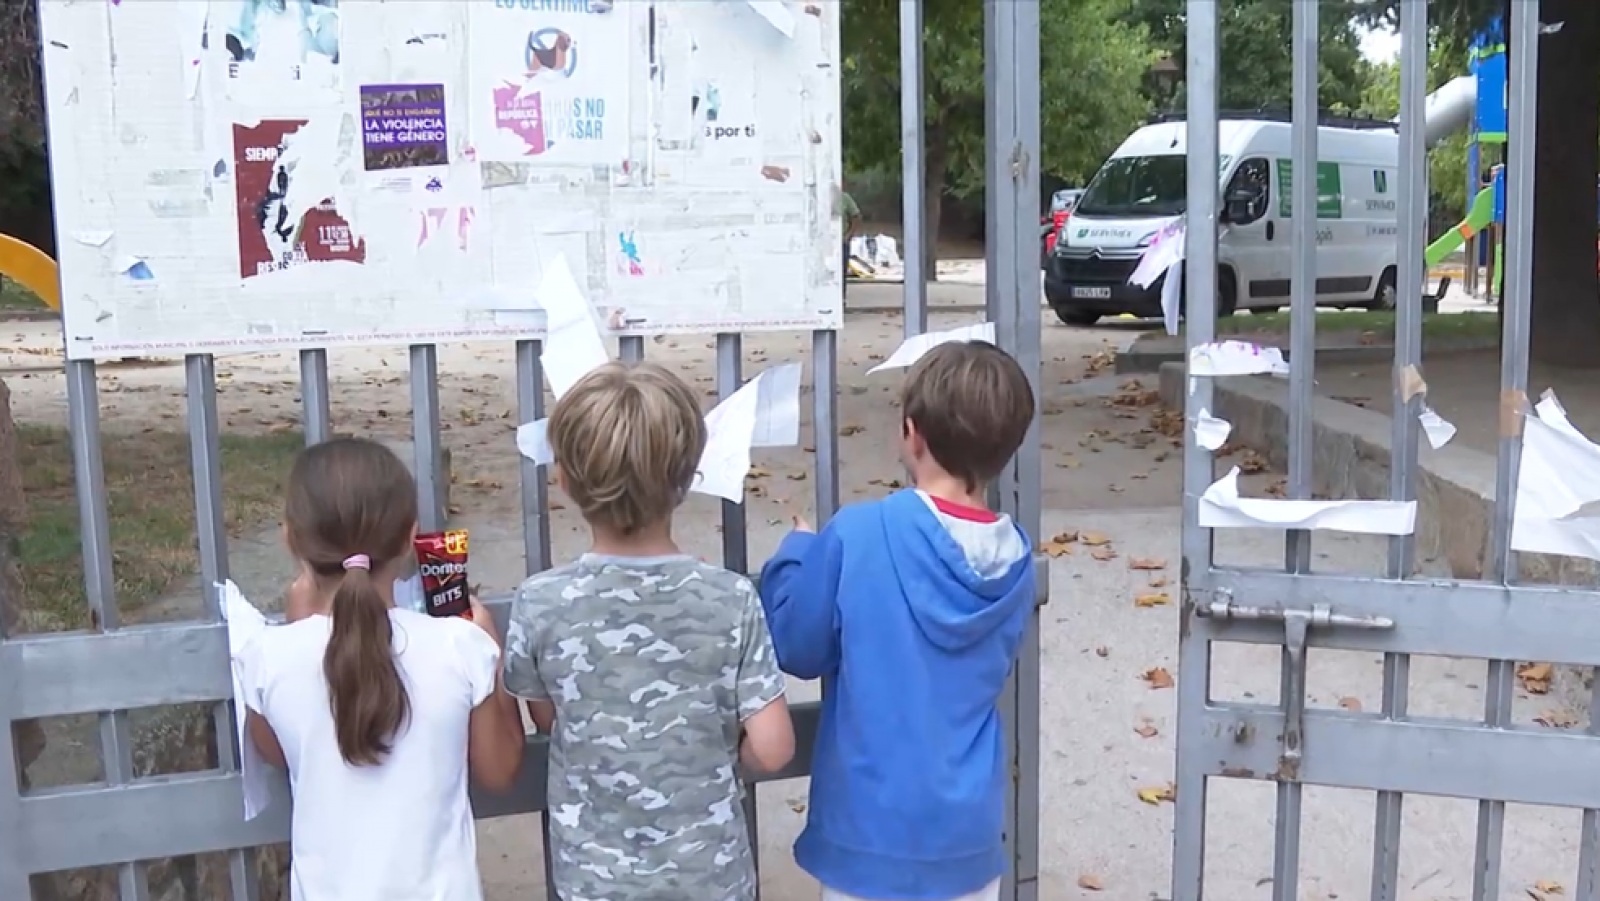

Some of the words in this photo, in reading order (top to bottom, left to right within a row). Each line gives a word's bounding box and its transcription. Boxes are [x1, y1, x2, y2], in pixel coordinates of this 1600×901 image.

[586, 98, 605, 118] NO
[365, 119, 380, 131] LA
[382, 118, 444, 131] VIOLENCIA
[715, 126, 740, 141] por
[744, 123, 755, 138] ti
[365, 132, 395, 144] TIENE
[432, 585, 463, 608] BITS
